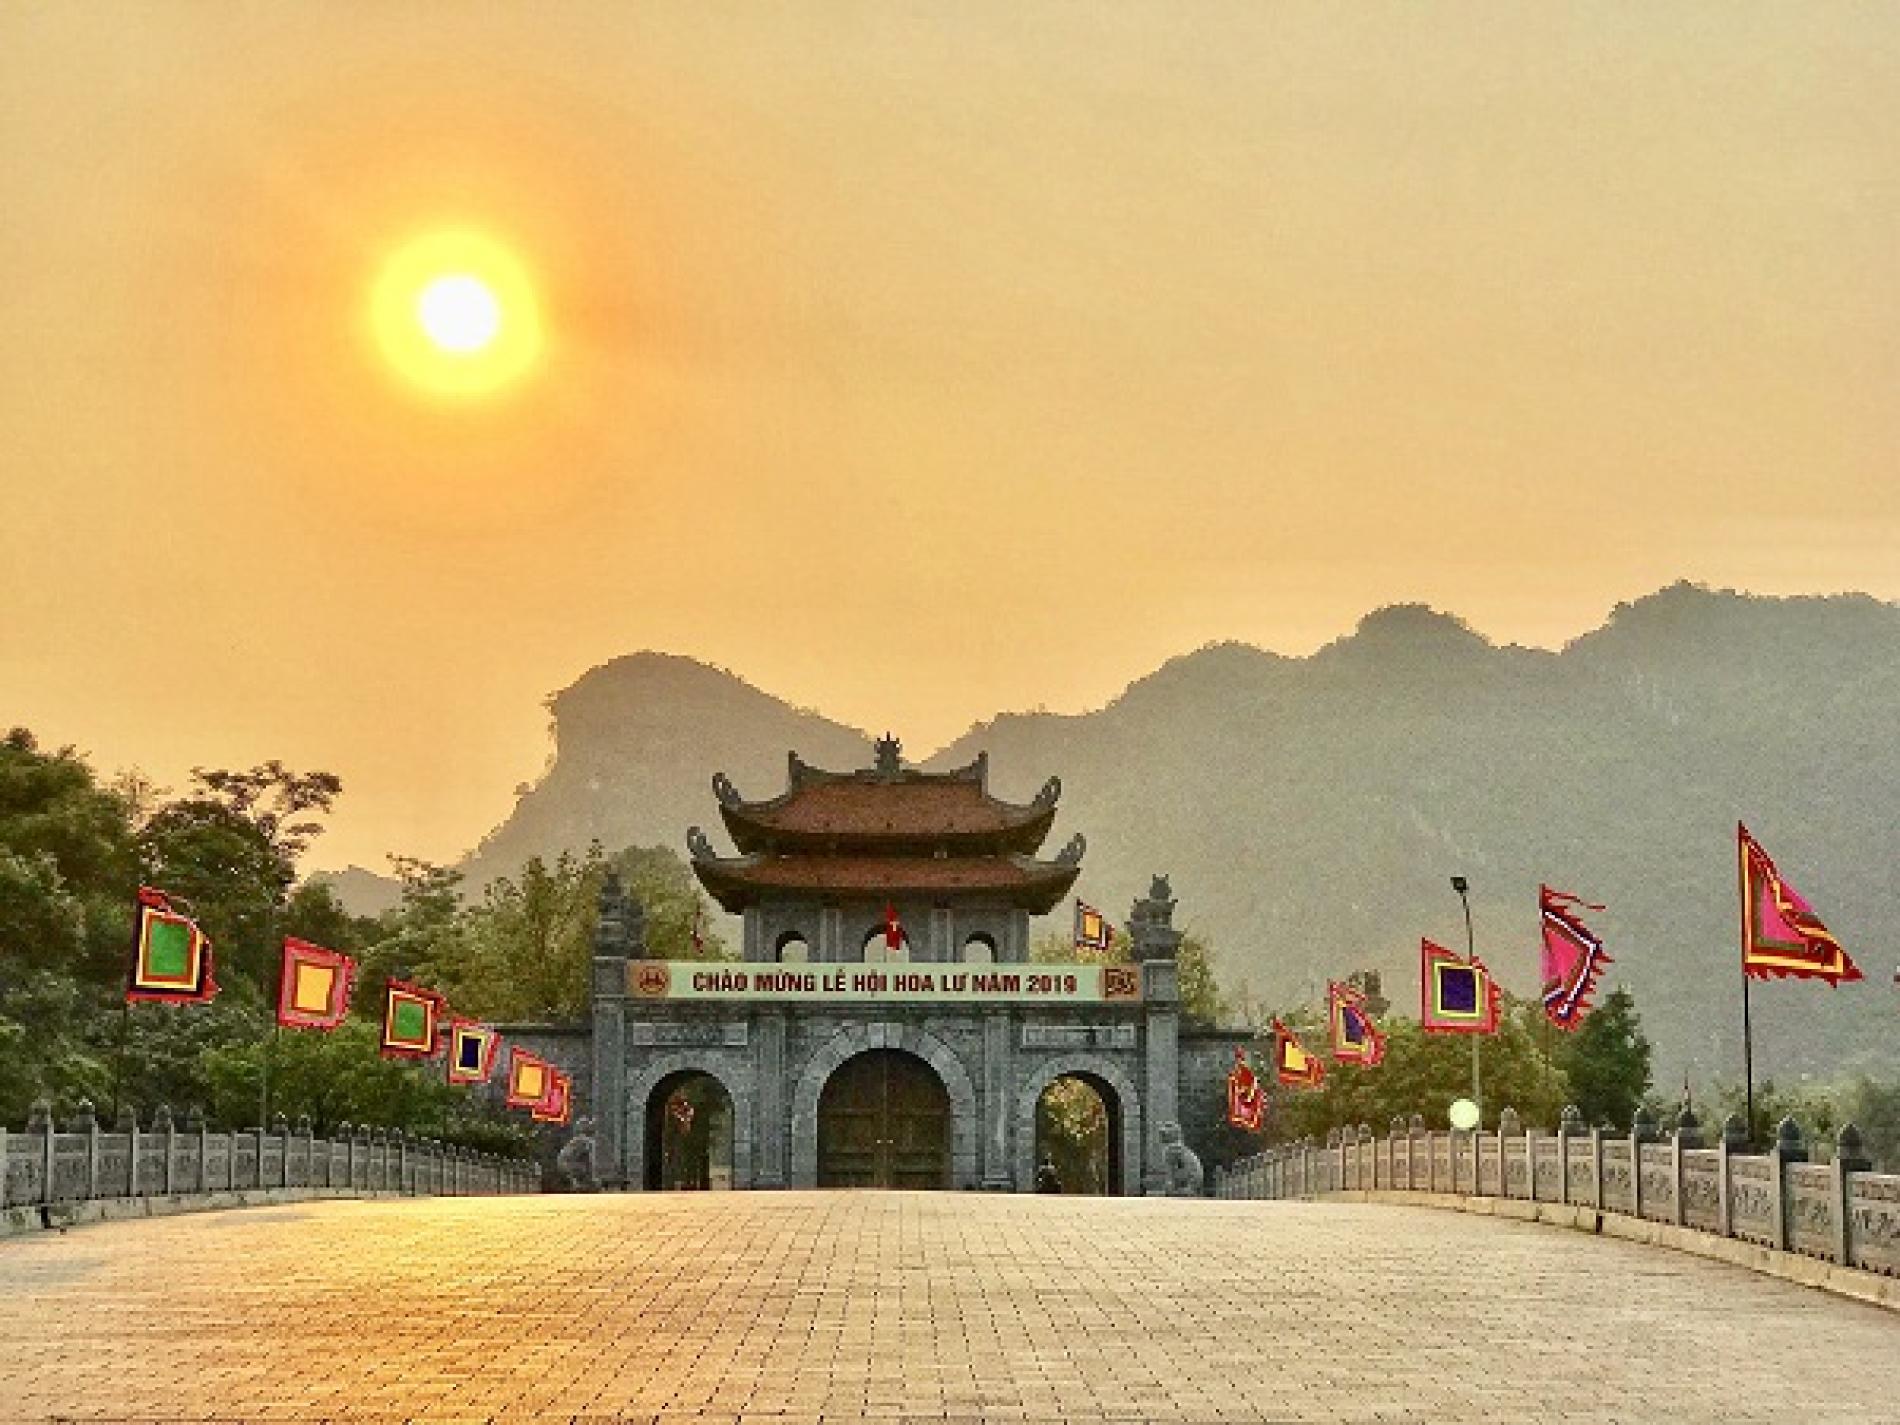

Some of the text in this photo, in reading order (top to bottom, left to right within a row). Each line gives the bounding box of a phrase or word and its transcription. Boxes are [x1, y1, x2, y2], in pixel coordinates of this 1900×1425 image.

[893, 973, 934, 992] HOA
[940, 971, 969, 992] LƯ
[1026, 973, 1077, 994] 2019
